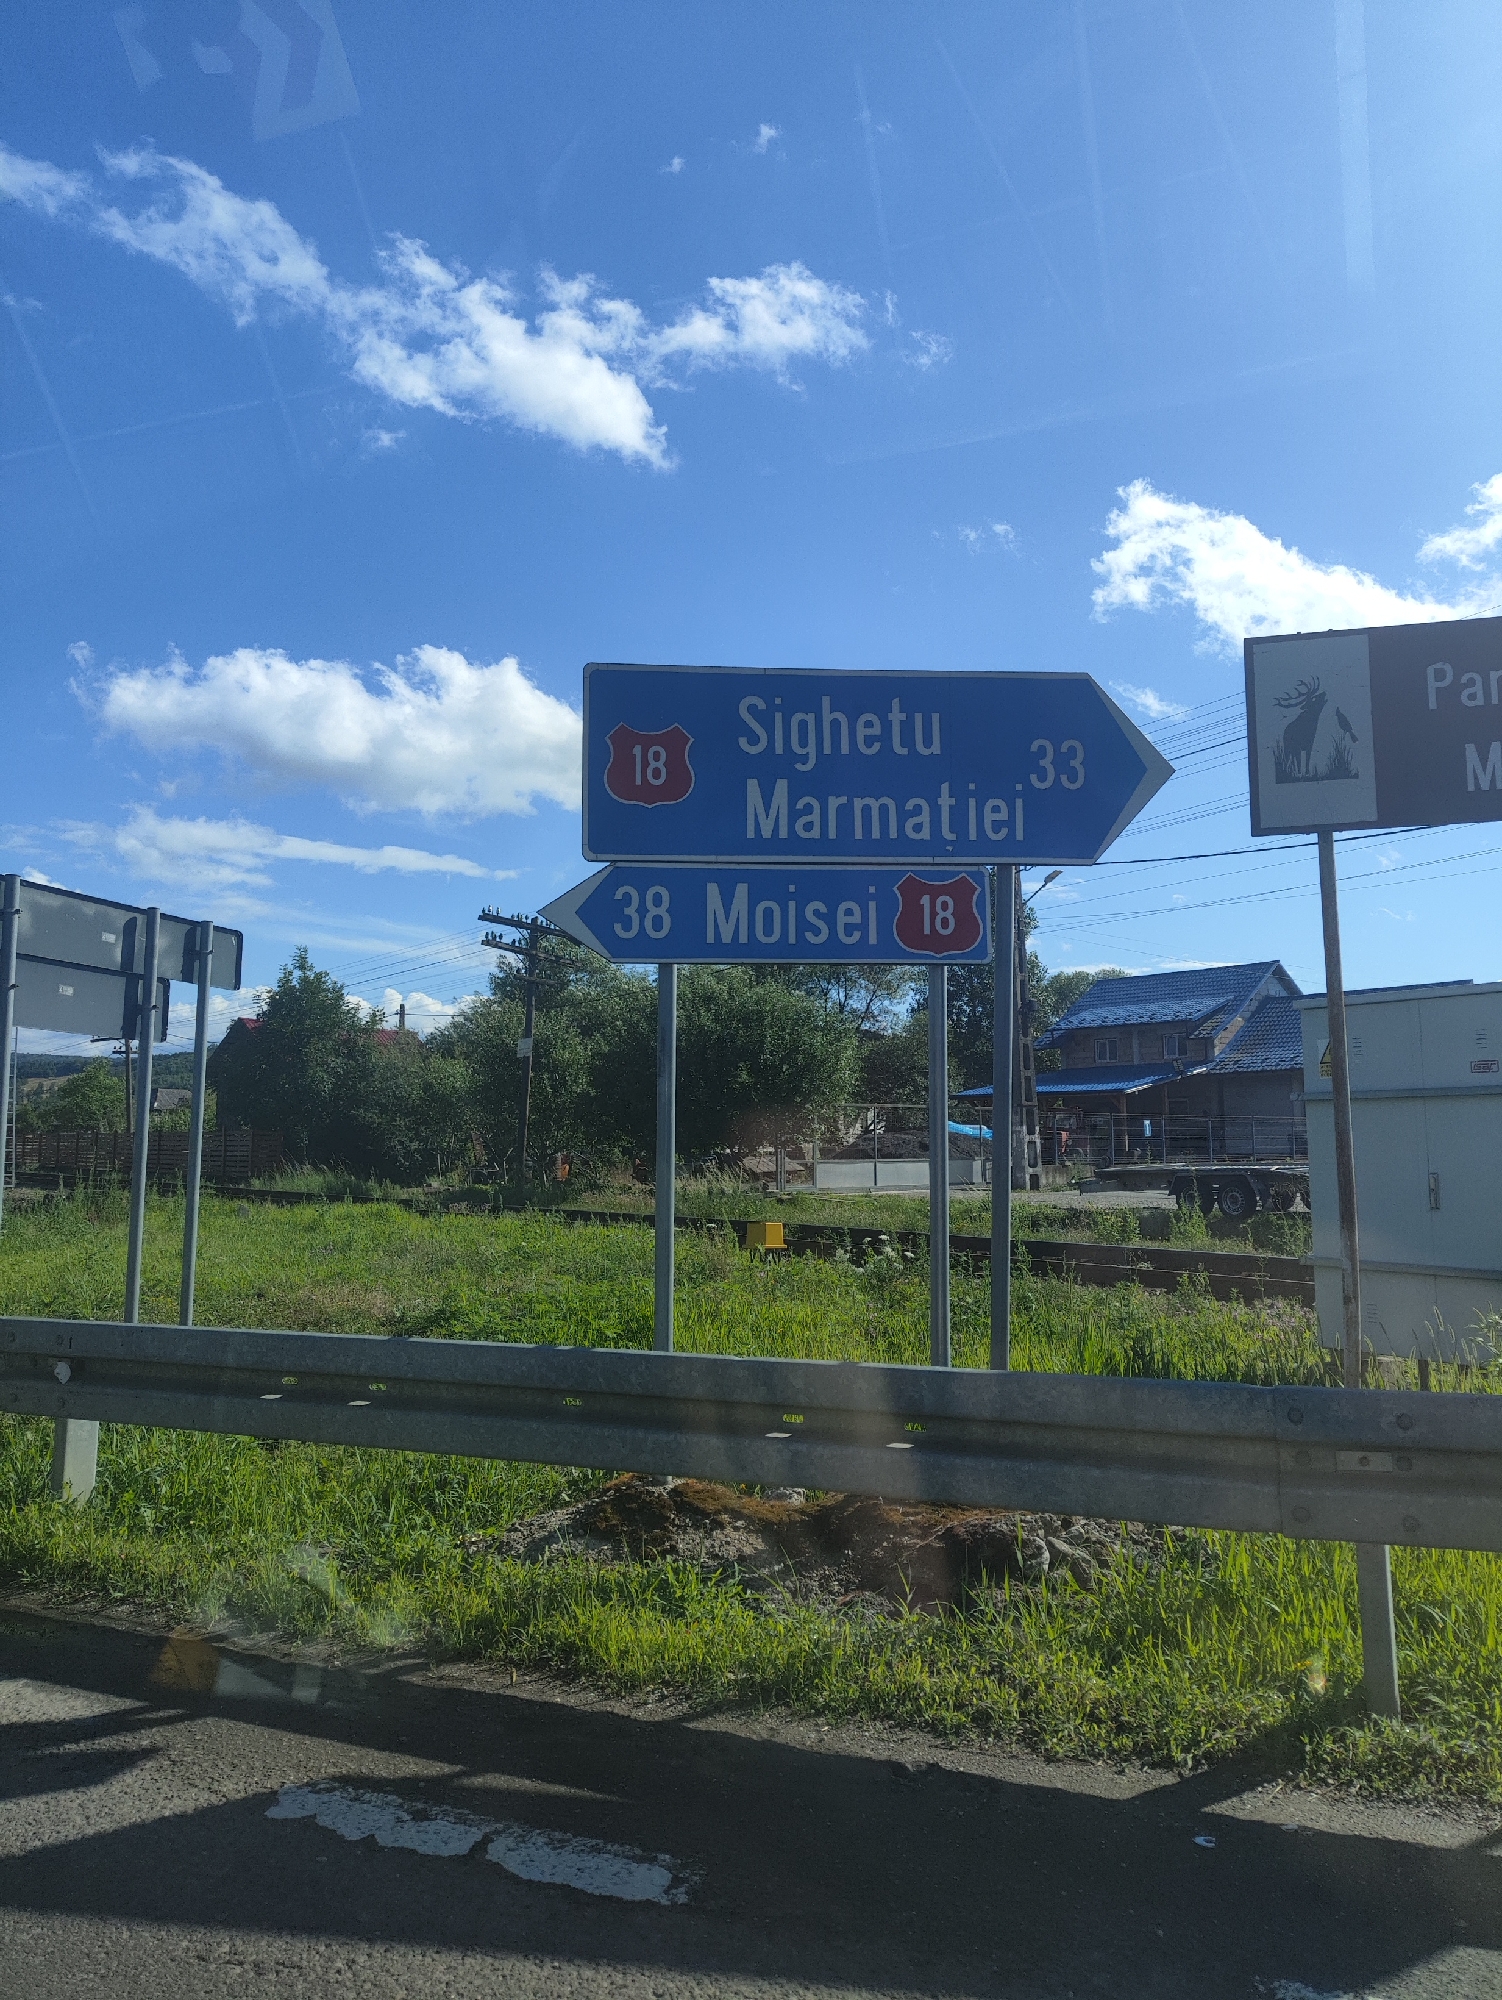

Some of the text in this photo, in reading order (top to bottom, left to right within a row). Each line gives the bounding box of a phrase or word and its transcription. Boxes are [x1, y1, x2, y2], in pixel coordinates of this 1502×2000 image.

[738, 694, 942, 773] Sighetu
[631, 744, 667, 786] 18
[1029, 738, 1086, 790] 33
[613, 883, 878, 944] 38 Moisei
[919, 894, 955, 936] 18
